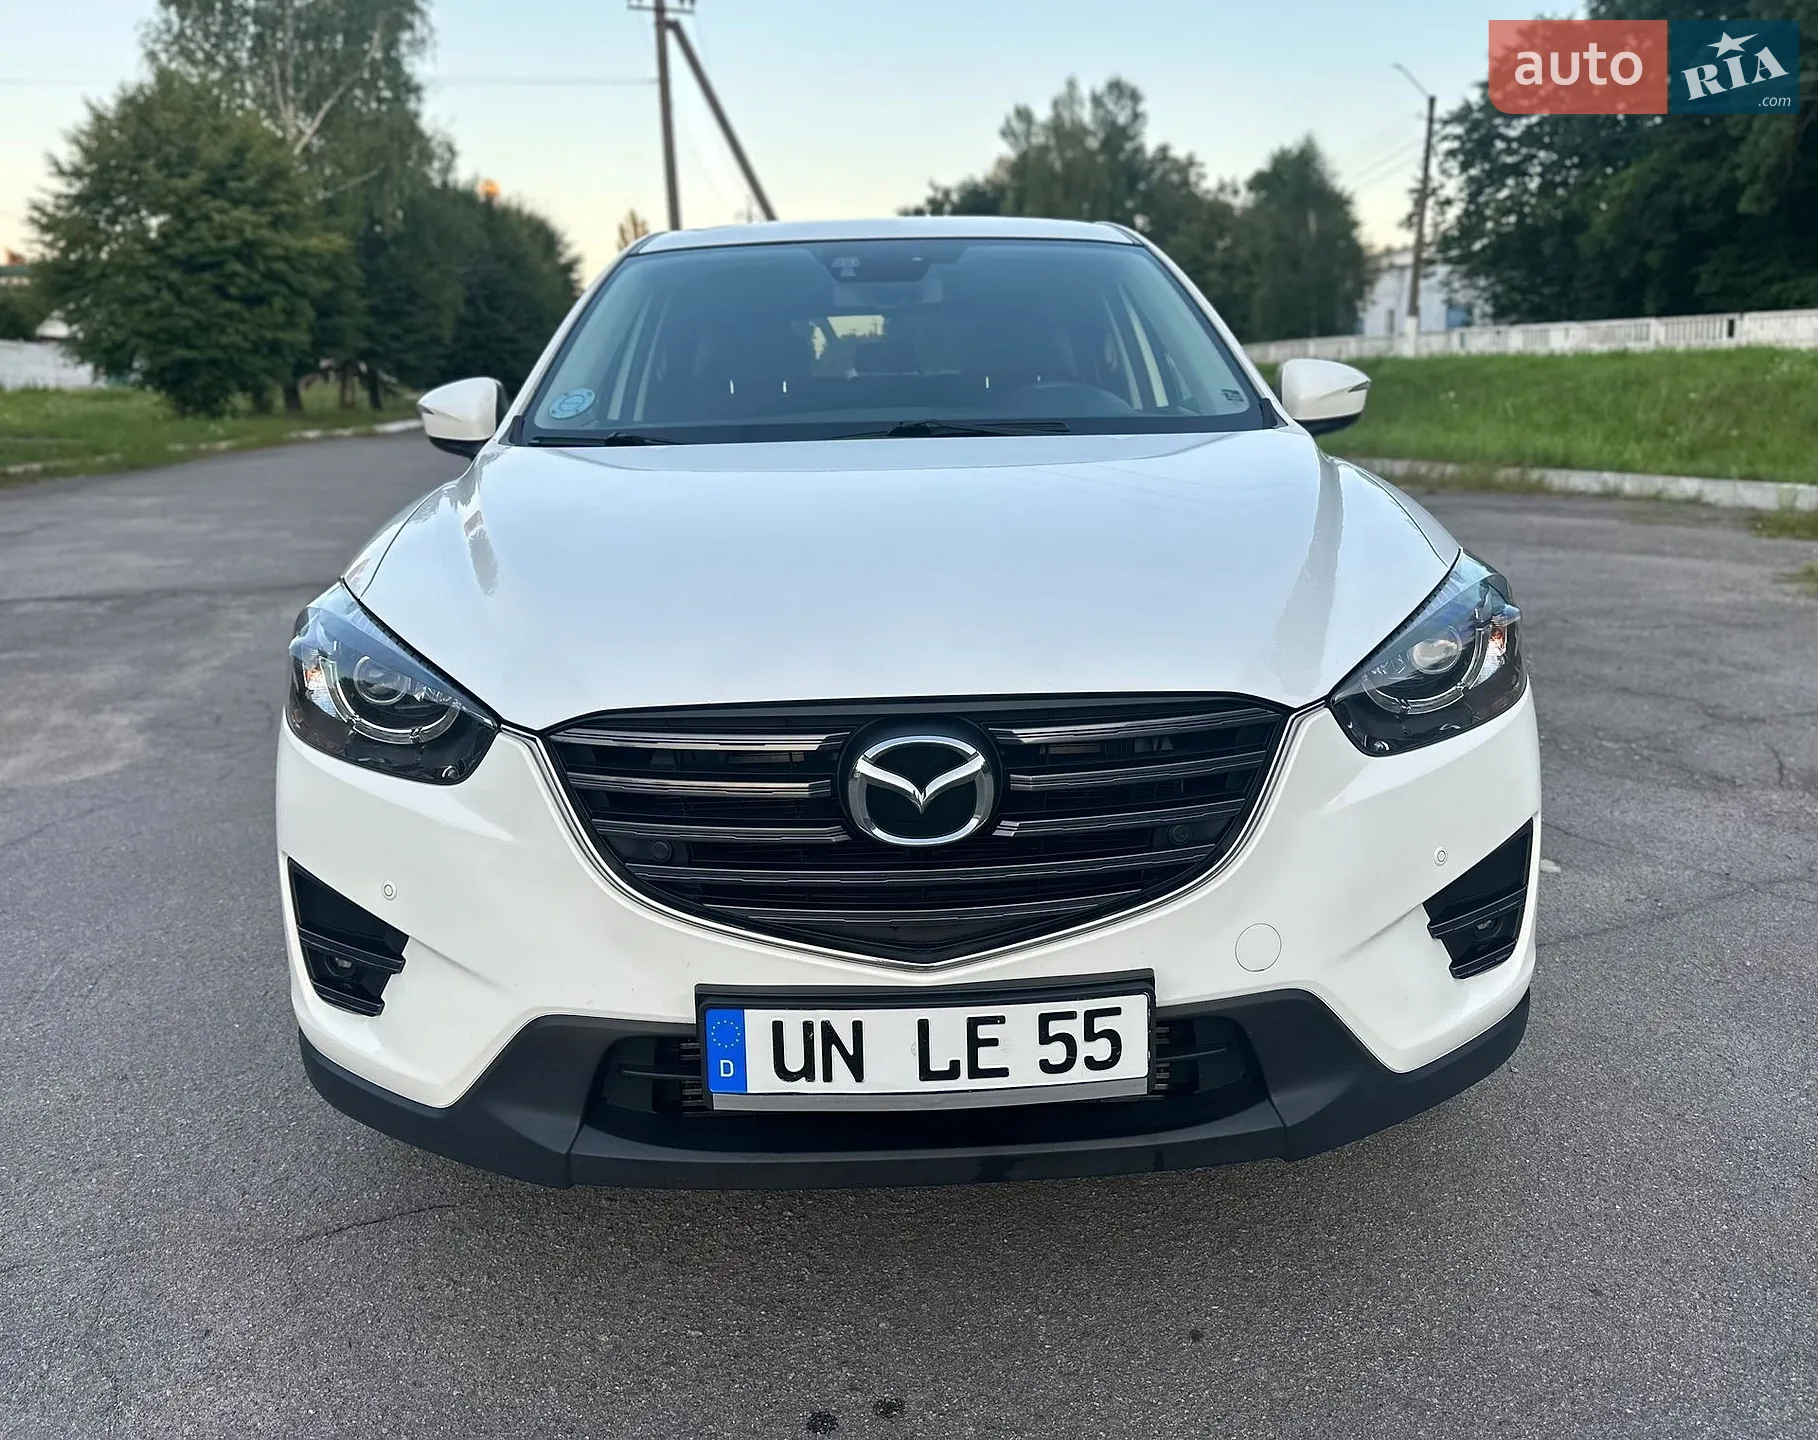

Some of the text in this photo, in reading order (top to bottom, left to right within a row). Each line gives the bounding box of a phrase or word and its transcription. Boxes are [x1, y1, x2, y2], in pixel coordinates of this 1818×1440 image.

[719, 1059, 735, 1078] D
[771, 1006, 1122, 1083] UN LE 55
